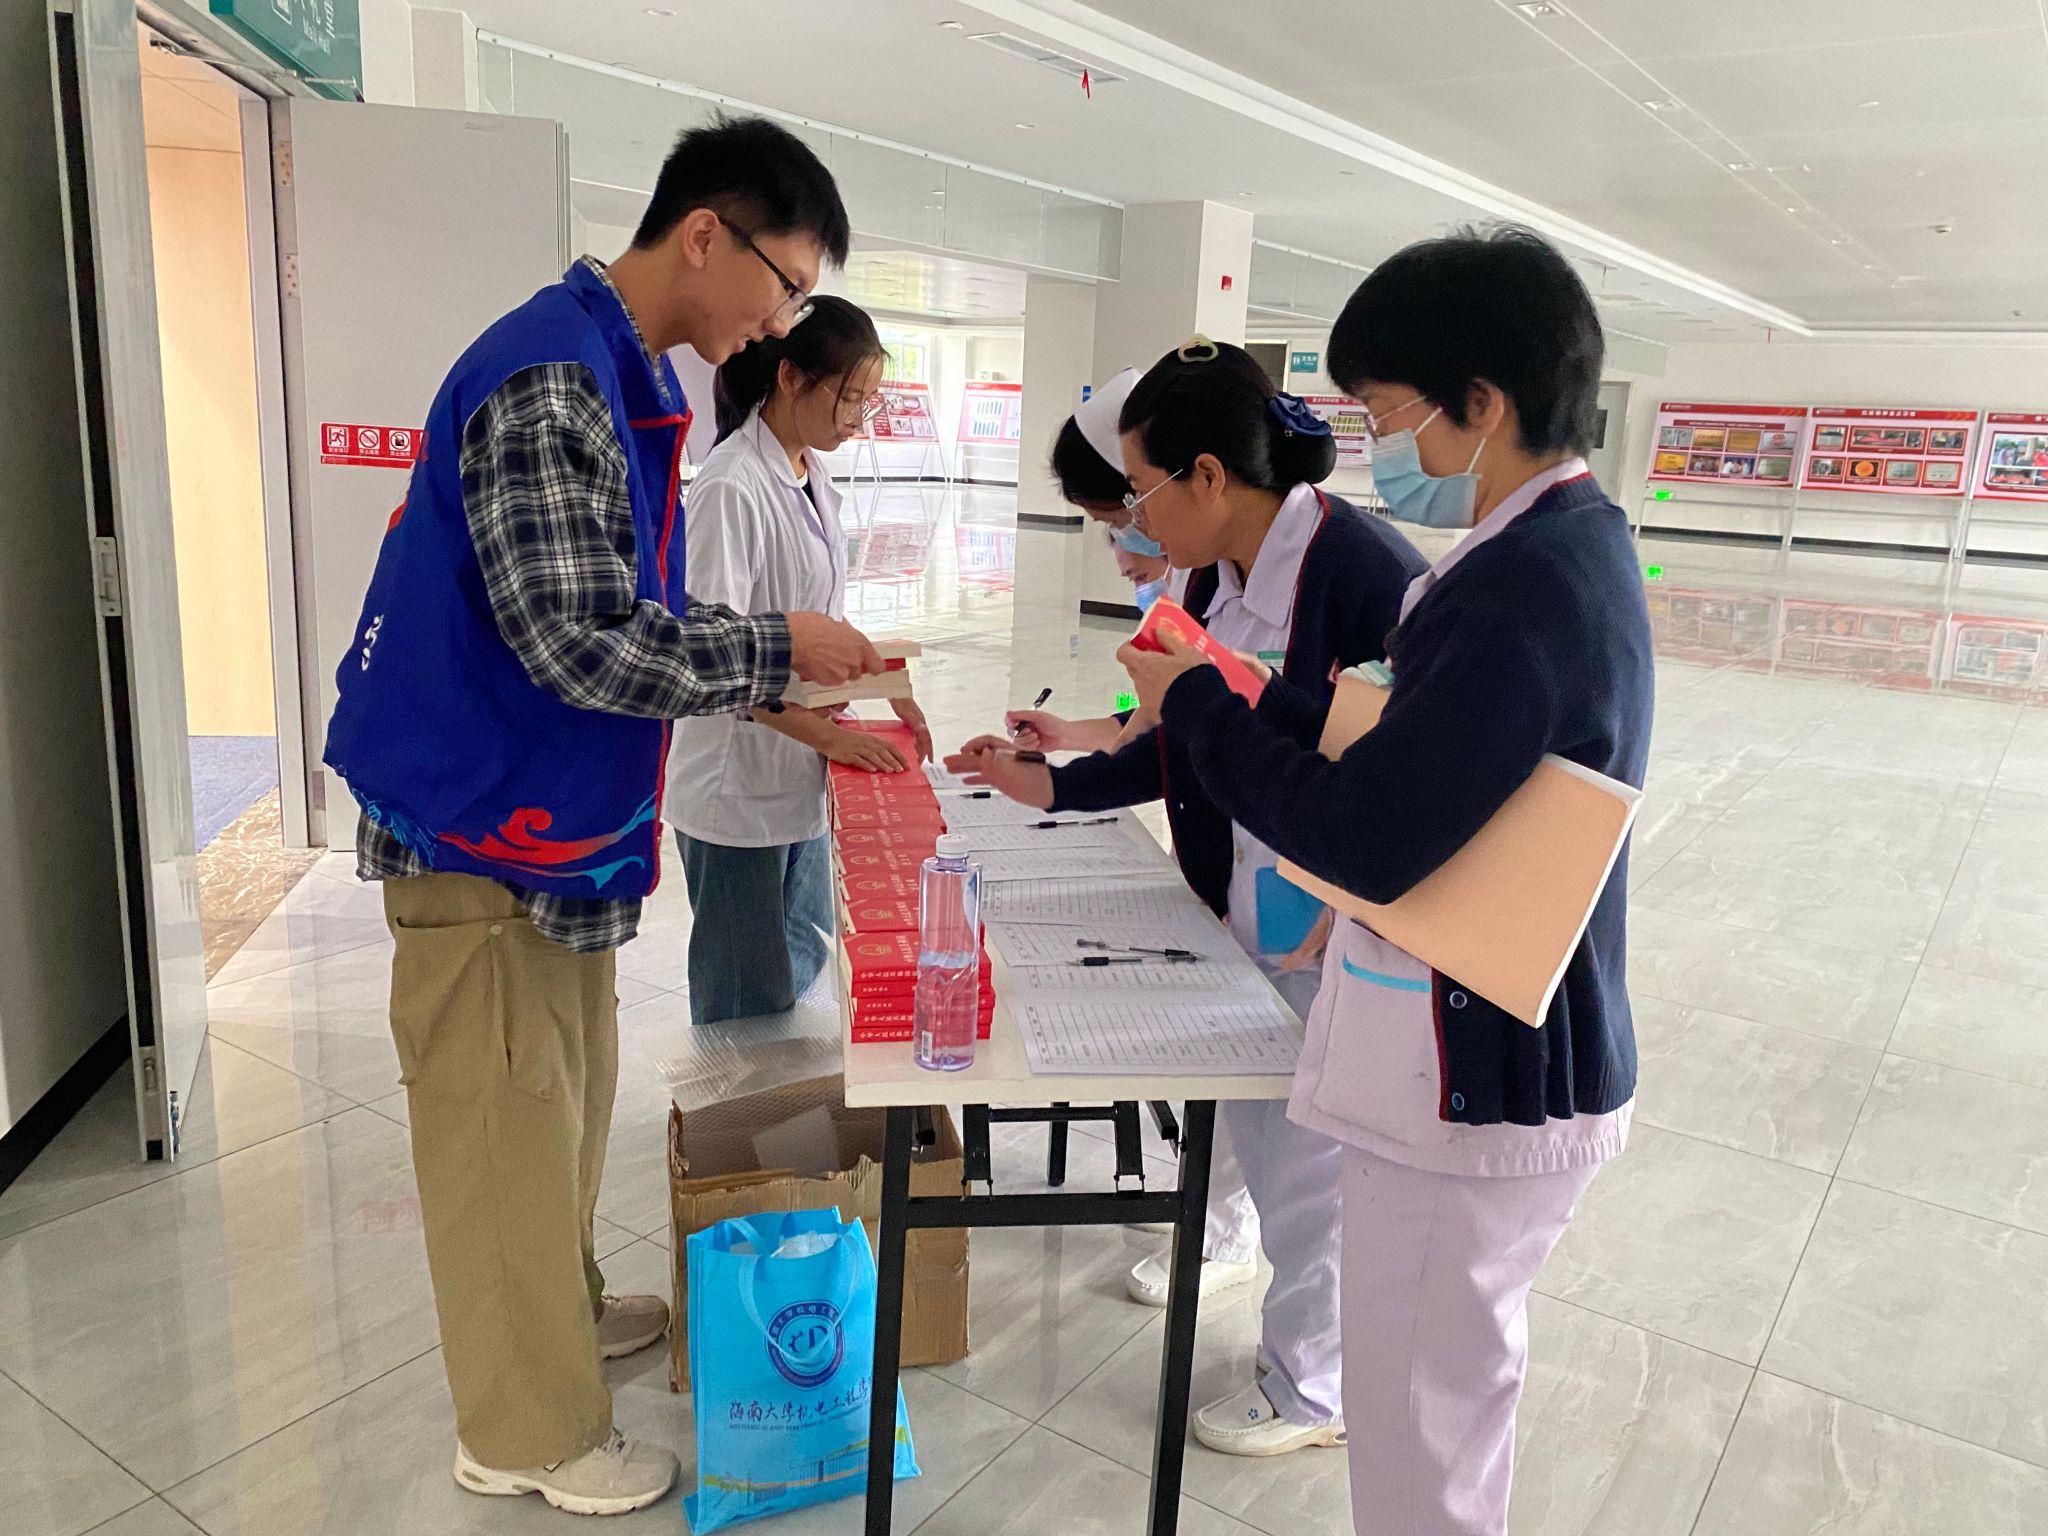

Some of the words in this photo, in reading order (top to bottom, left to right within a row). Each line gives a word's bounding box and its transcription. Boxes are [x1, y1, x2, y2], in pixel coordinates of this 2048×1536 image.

[859, 1030, 914, 1039] 中华人民共和国
[728, 1376, 873, 1423] 海南大学机电工程学
